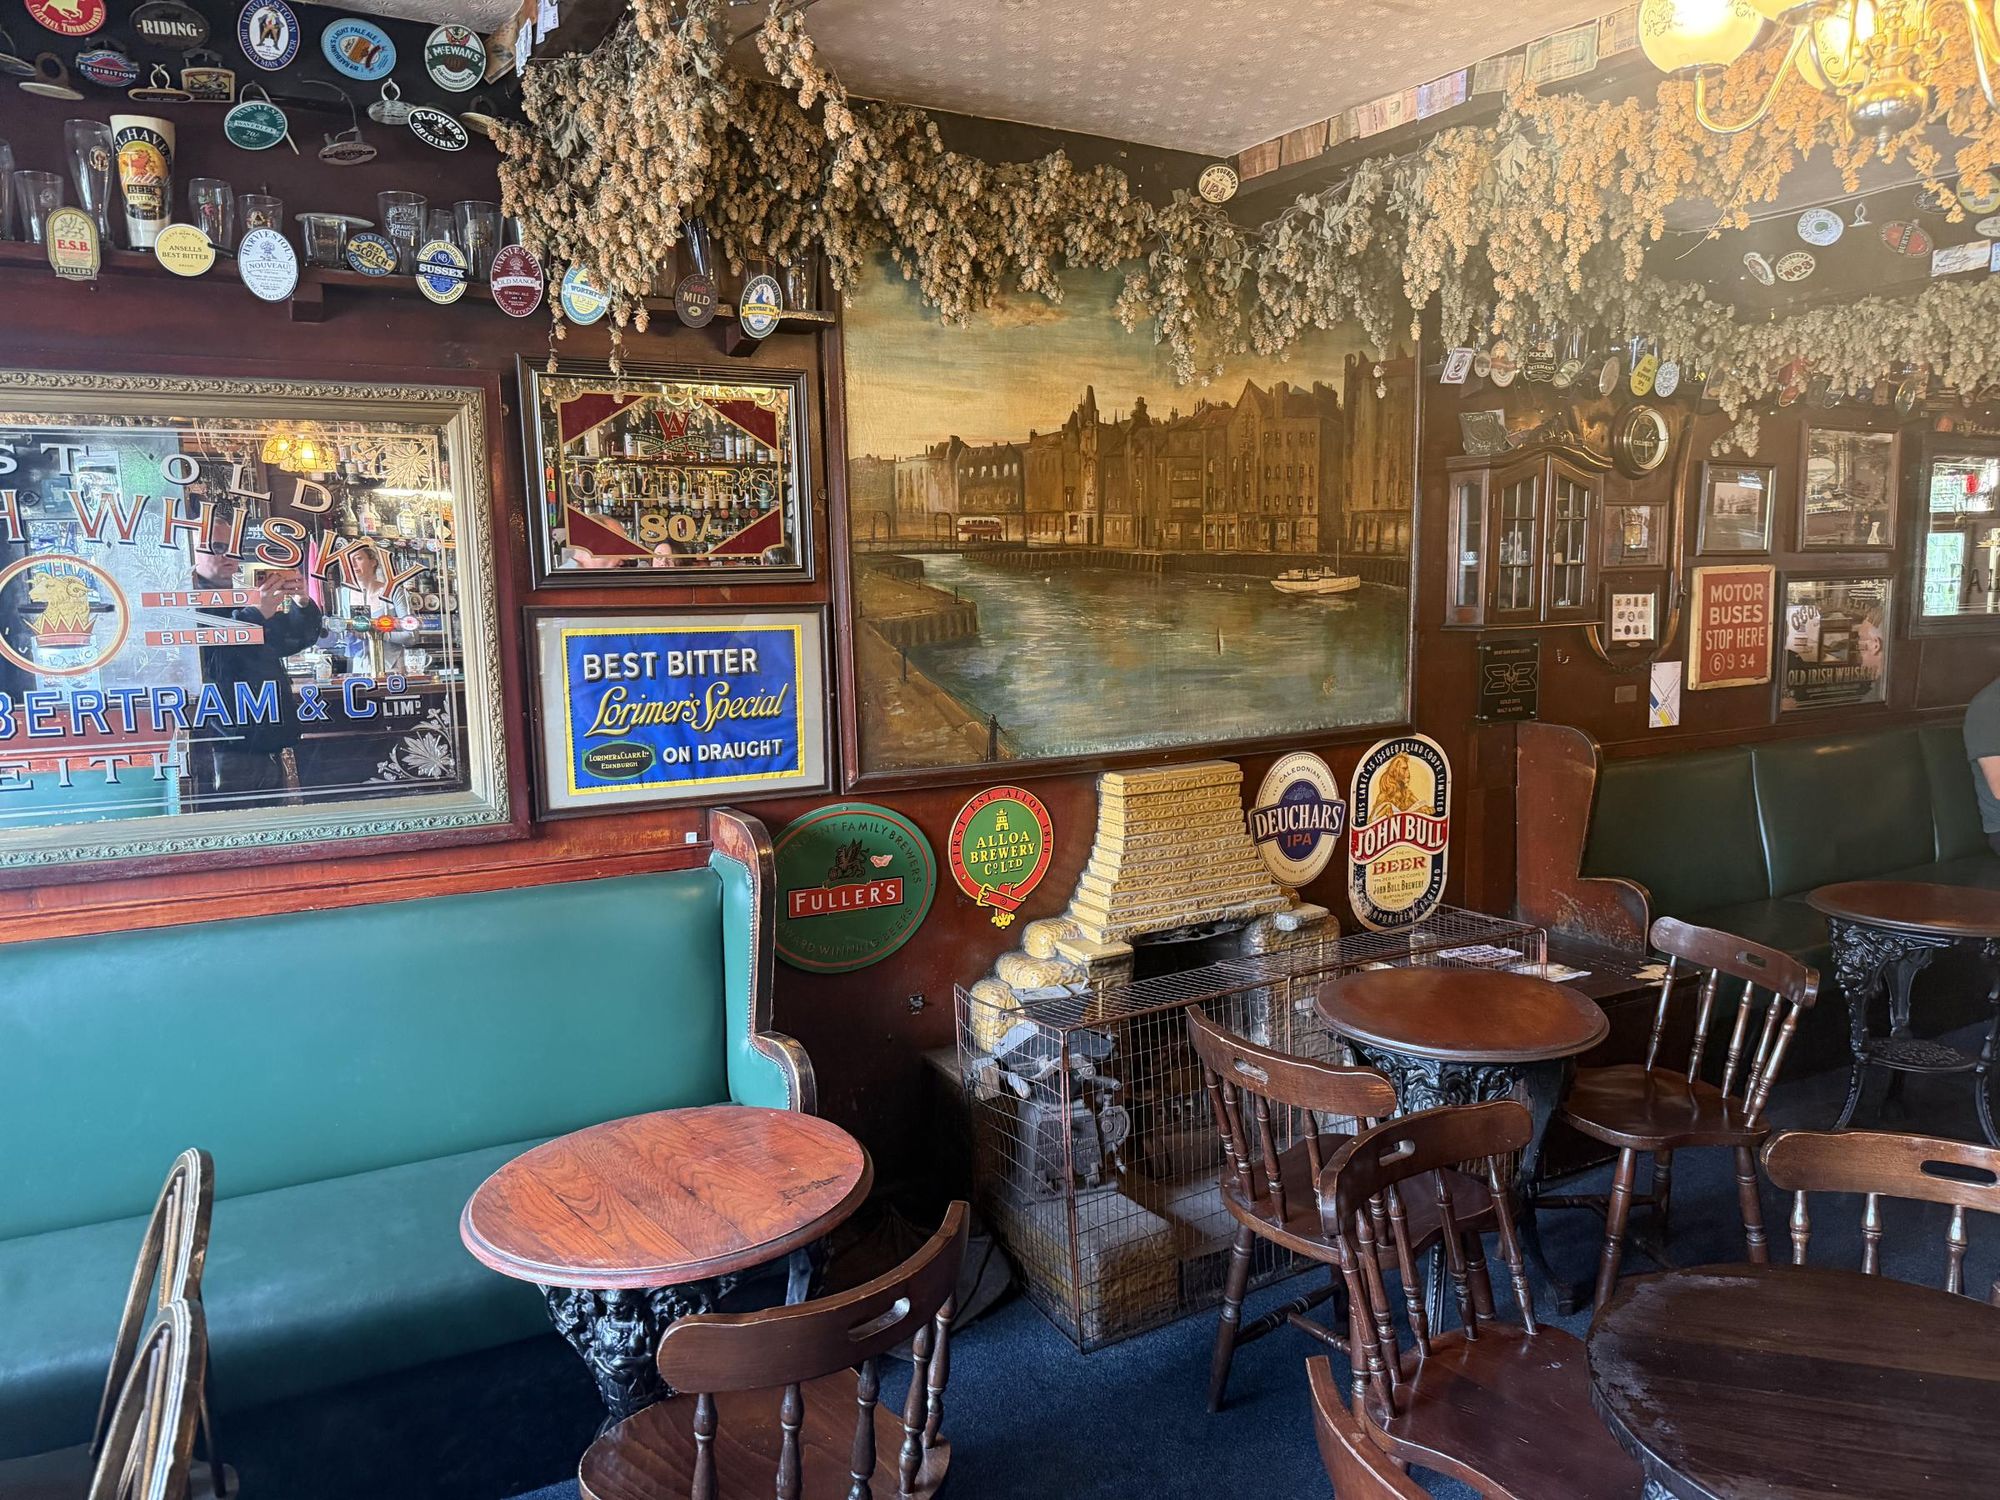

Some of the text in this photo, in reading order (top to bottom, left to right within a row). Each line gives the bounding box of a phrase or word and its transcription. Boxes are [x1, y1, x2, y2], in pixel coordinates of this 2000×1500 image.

[142, 19, 198, 37] RIDING
[80, 64, 137, 79] EXHIBITION
[413, 122, 459, 148] ORIGINAL
[414, 112, 465, 141] FLOWERS
[115, 128, 172, 166] ELHAVE
[162, 251, 209, 261] BEST BITTER
[169, 244, 202, 252] ANSELLS
[355, 244, 389, 267] SCOTCH
[249, 262, 289, 270] NOUVEAU
[419, 264, 465, 279] SUSSEX
[683, 292, 711, 305] MILD
[160, 453, 334, 514] OLD
[569, 465, 776, 503] CALDER'S
[640, 513, 722, 543] 80/-
[66, 489, 429, 604] WHISKY
[159, 591, 250, 606] HEAD
[1710, 583, 1764, 604] MOTOR
[1709, 604, 1764, 626] BUSES
[160, 630, 250, 645] BLEND
[1705, 626, 1766, 652] STOP HERE
[583, 648, 758, 681] BEST BITTER
[1740, 652, 1756, 670] 34
[1788, 670, 1806, 686] OLD
[1808, 667, 1834, 685] IRISH
[298, 689, 329, 721] &
[584, 681, 789, 738] Lorimer's Special
[663, 738, 783, 764] ON DRAUGHT
[1374, 744, 1400, 764] ISSUED
[1400, 743, 1410, 752] BY
[601, 761, 638, 770] EDINBURGH
[1424, 749, 1443, 772] COOPE
[1279, 766, 1322, 784] CALEDONIAN
[1359, 771, 1370, 799] LABEL
[1436, 774, 1446, 812] LIMITED
[1255, 802, 1342, 839] DEUCHARS
[1358, 802, 1367, 824] THIS
[953, 821, 966, 866] FIRST
[1004, 788, 1043, 816] ALLOA
[1042, 823, 1051, 855] 1810
[1356, 814, 1446, 858] JOHN BULL
[976, 830, 1030, 849] ALLOA
[1287, 833, 1313, 847] IPA
[841, 821, 889, 834] FAMILY
[888, 830, 923, 886] BREWERS
[970, 843, 1036, 865] BREWERY
[1372, 856, 1427, 876] BEER
[795, 883, 897, 913] FULLER'S
[1373, 880, 1425, 895] JOHN BULL BREWERY
